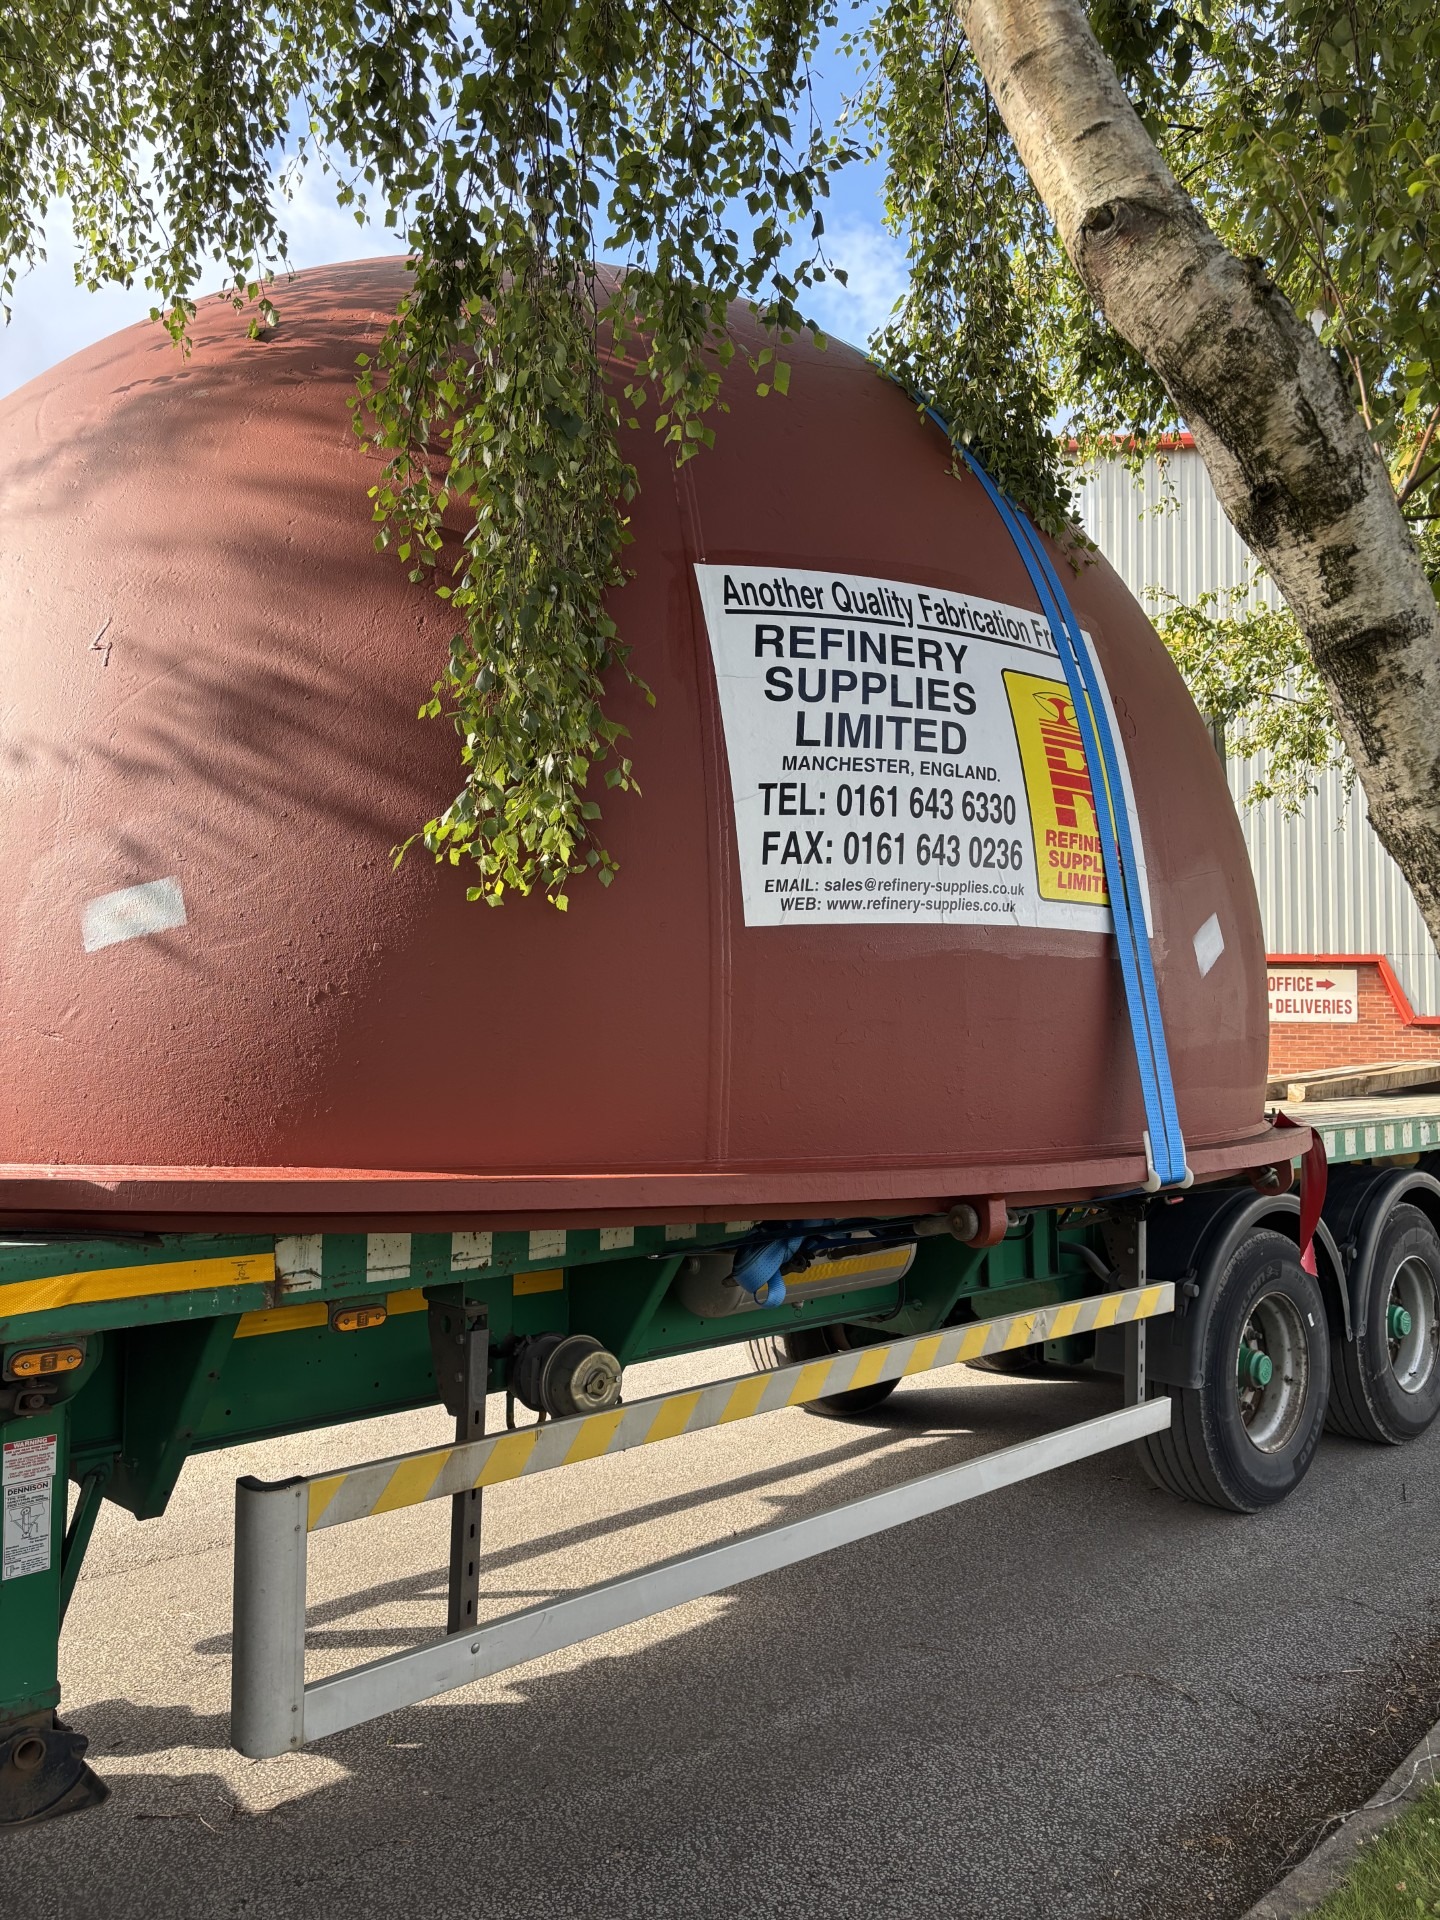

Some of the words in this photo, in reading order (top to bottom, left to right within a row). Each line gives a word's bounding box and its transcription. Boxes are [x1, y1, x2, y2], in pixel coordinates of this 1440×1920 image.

[723, 574, 824, 610] Another
[831, 581, 914, 628] Quality
[917, 593, 1032, 644] Fabrication
[1030, 618, 1060, 652] Fr
[754, 623, 968, 675] REFINERY
[763, 665, 977, 716] SUPPLIES
[795, 710, 967, 755] LIMITED
[781, 755, 915, 777] MANCHESTER,
[919, 760, 1001, 783] ENGLAND.
[757, 782, 826, 816] TEL:
[836, 783, 898, 818] 0161
[908, 786, 954, 821] 643
[961, 790, 1017, 826] 6330
[761, 830, 833, 866] FAX:
[843, 831, 905, 866] 0161
[916, 833, 961, 868] 643
[968, 836, 1024, 871] 0236
[1045, 829, 1102, 854] REFINE
[1048, 849, 1105, 874] SUPPL
[763, 878, 819, 893] EMAIL:
[823, 876, 1025, 896] sales@refinery-supplies.co.uk
[1057, 871, 1109, 894] LIMITE
[780, 896, 822, 911] WEB:
[826, 895, 1017, 913] www.refinery-supplies.co.uk
[1267, 976, 1314, 992] OFFICE
[1275, 998, 1353, 1014] DELIVERIES
[13, 1437, 48, 1449] WARNING
[7, 1480, 49, 1496] DENNISON
